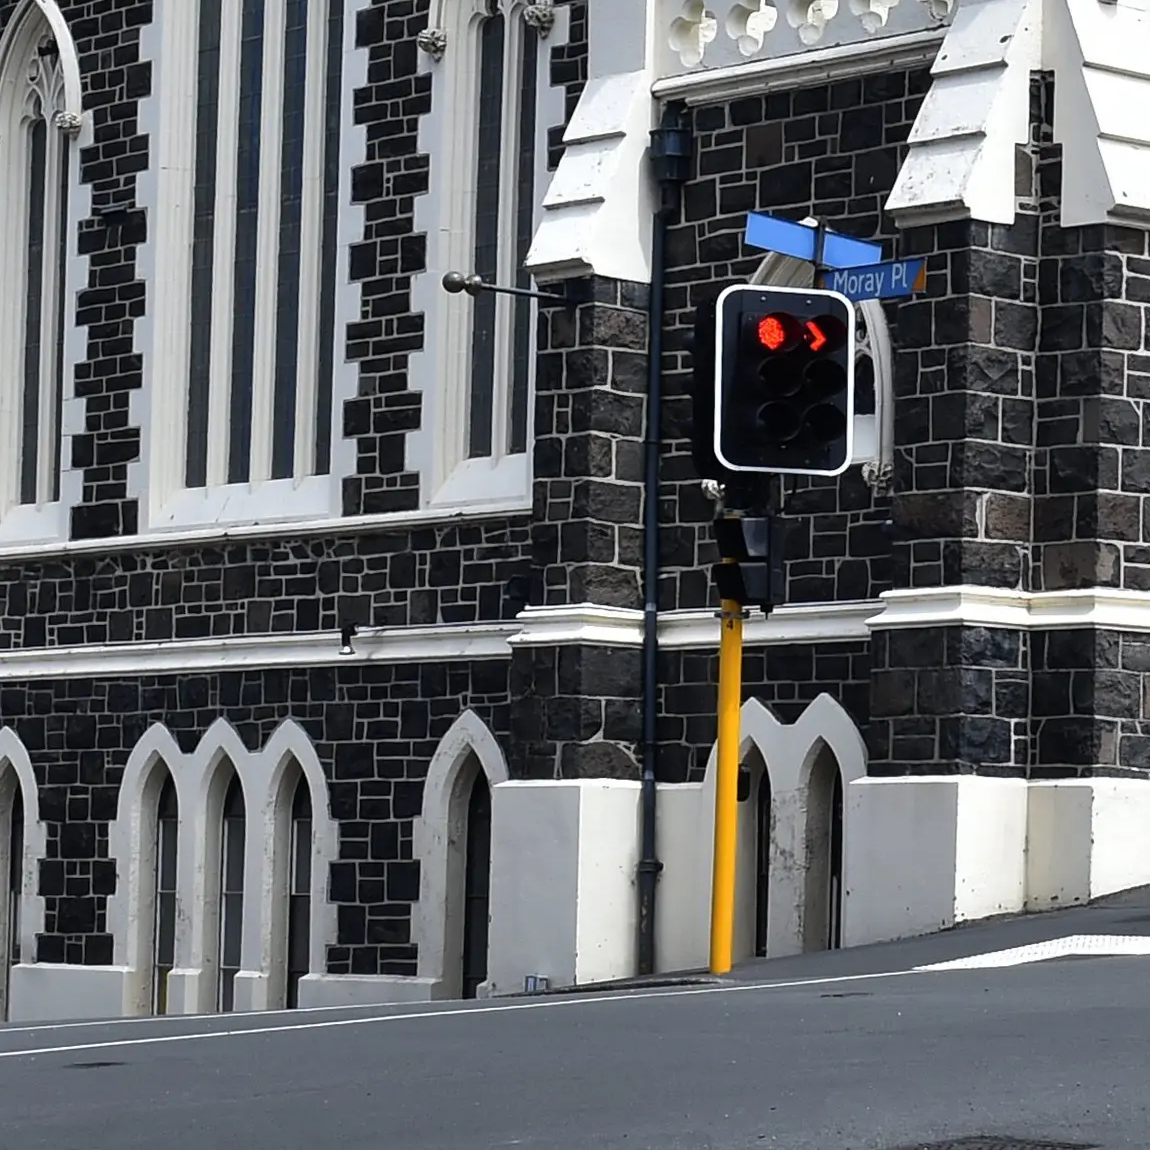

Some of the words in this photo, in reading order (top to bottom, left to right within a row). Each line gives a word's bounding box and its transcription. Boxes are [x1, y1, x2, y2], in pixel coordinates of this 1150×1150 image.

[833, 270, 885, 297] Moray
[891, 262, 908, 290] Pl
[726, 618, 734, 630] 4
